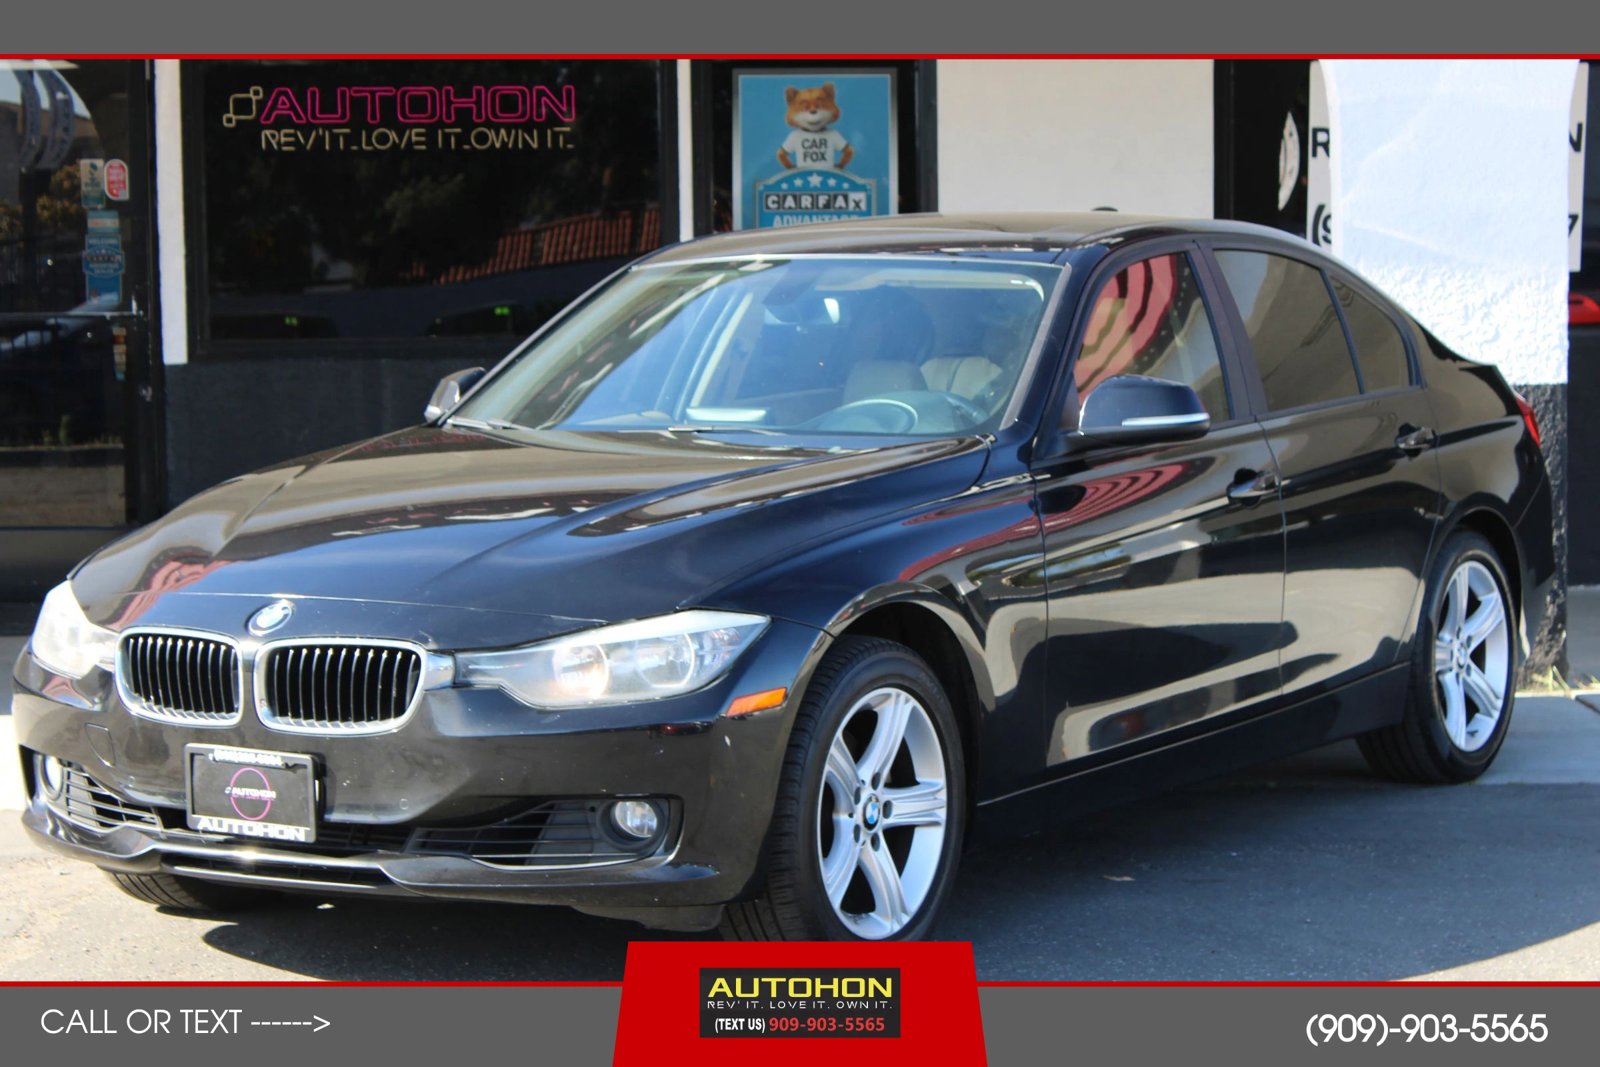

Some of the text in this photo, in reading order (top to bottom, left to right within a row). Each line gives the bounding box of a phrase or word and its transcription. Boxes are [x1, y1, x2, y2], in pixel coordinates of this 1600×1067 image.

[260, 85, 577, 124] AUTOHON
[361, 127, 427, 150] LOVE
[470, 127, 538, 150] OWN
[801, 137, 828, 150] CAR
[803, 150, 828, 163] FOX
[766, 193, 865, 211] CARFAX
[197, 818, 306, 841] AUTOHON
